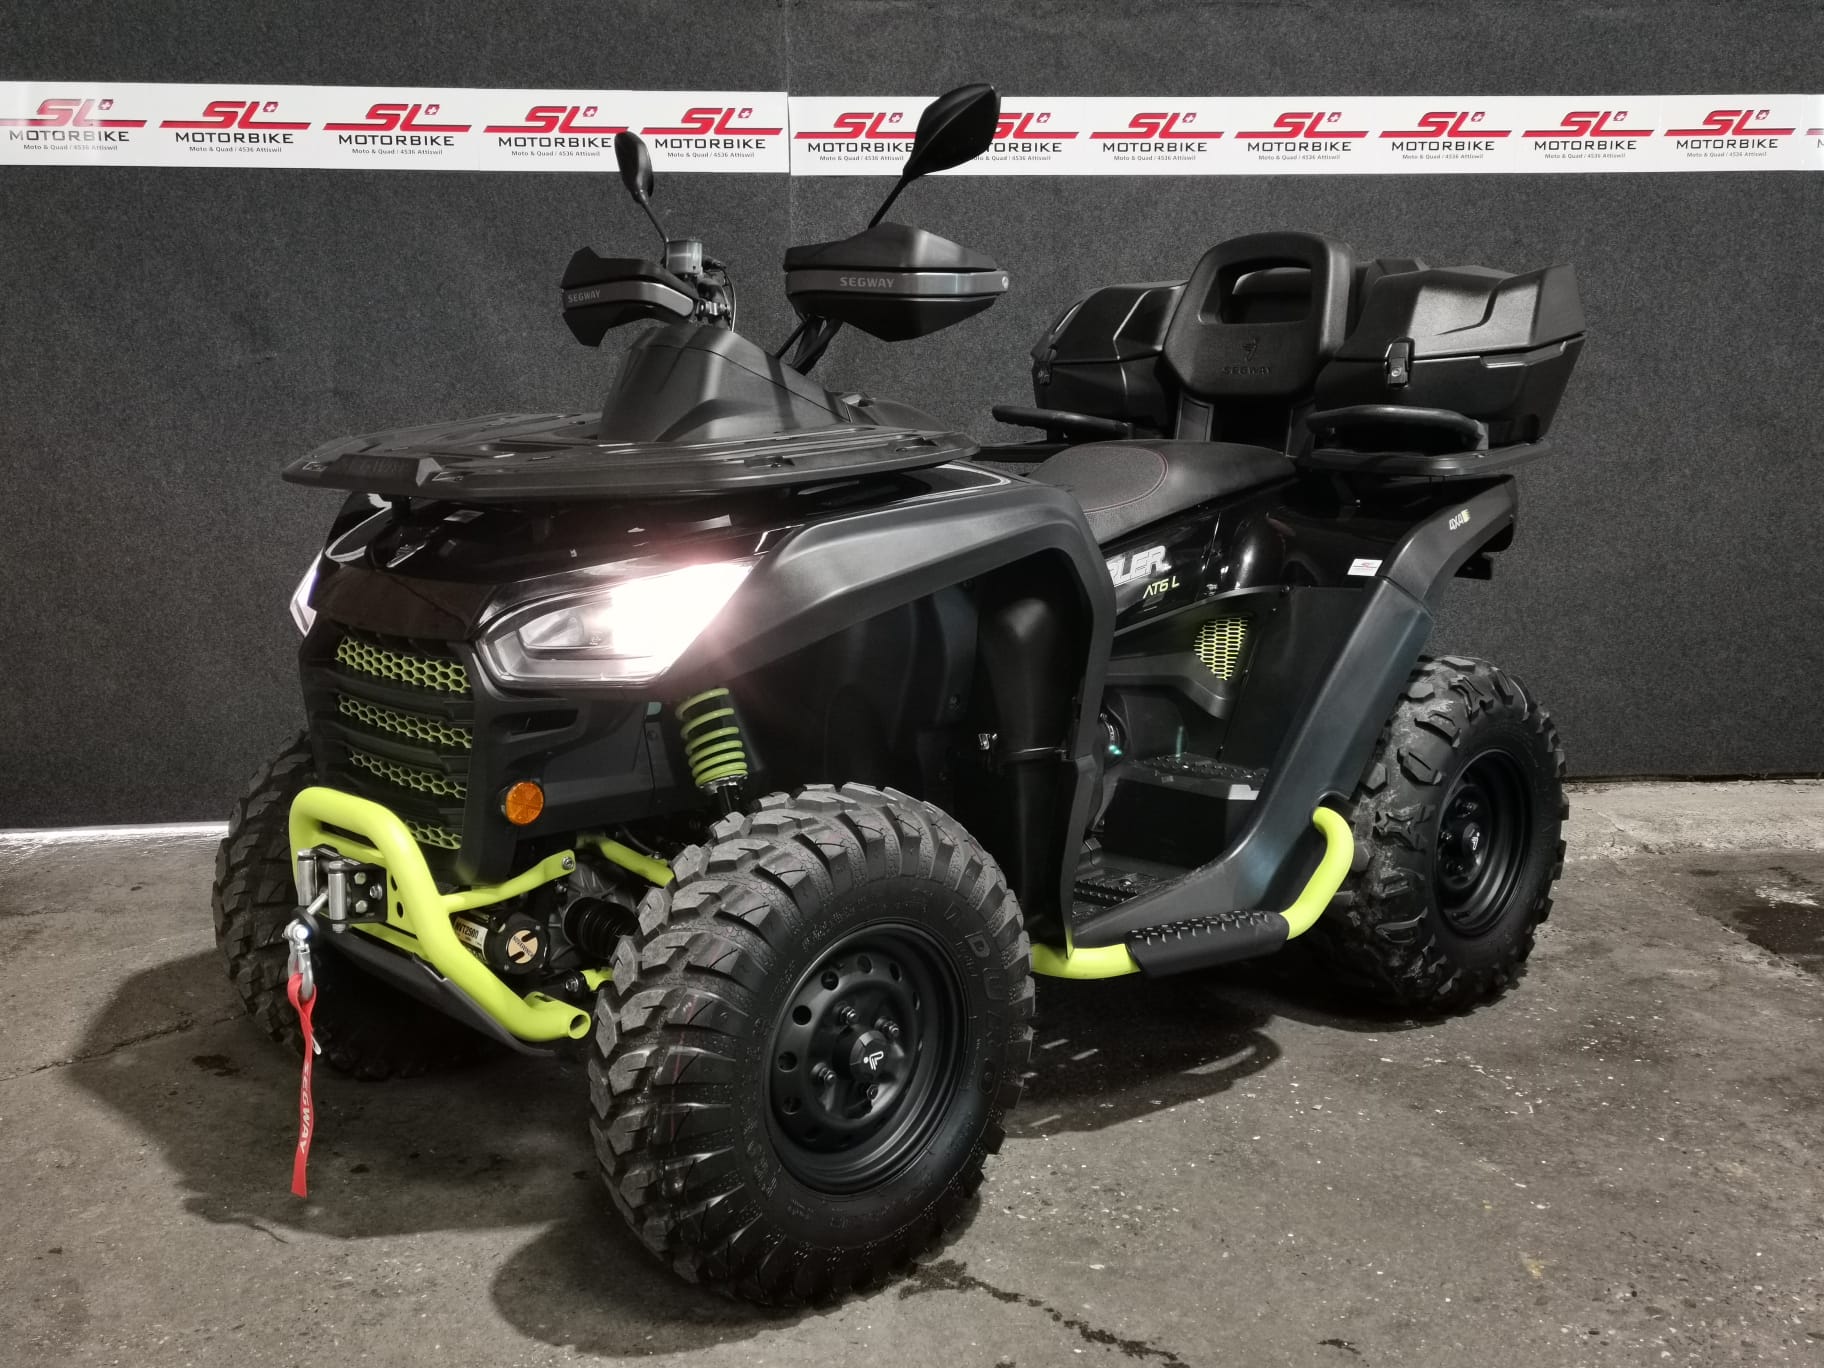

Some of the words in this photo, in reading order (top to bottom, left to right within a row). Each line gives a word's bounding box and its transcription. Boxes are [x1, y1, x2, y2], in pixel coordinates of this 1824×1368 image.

[9, 130, 130, 141] MOTORBIKE
[175, 132, 294, 144] MOTORBIKE
[338, 135, 455, 146] MOTORBIKE
[498, 137, 612, 148] MOTORBIKE
[654, 139, 766, 149] MOTORBIKE
[807, 142, 915, 153] MOTORBIKE
[986, 142, 1063, 153] TORBIKE
[1102, 142, 1208, 153] MOTORBIKE
[1247, 141, 1352, 152] MOTORBIKE
[1391, 141, 1495, 151] MOTORBIKE
[1534, 140, 1638, 151] MOTORBIKE
[1676, 138, 1779, 150] MOTORBIKE
[840, 276, 895, 288] SEGWAY
[567, 289, 601, 304] SEGWAY
